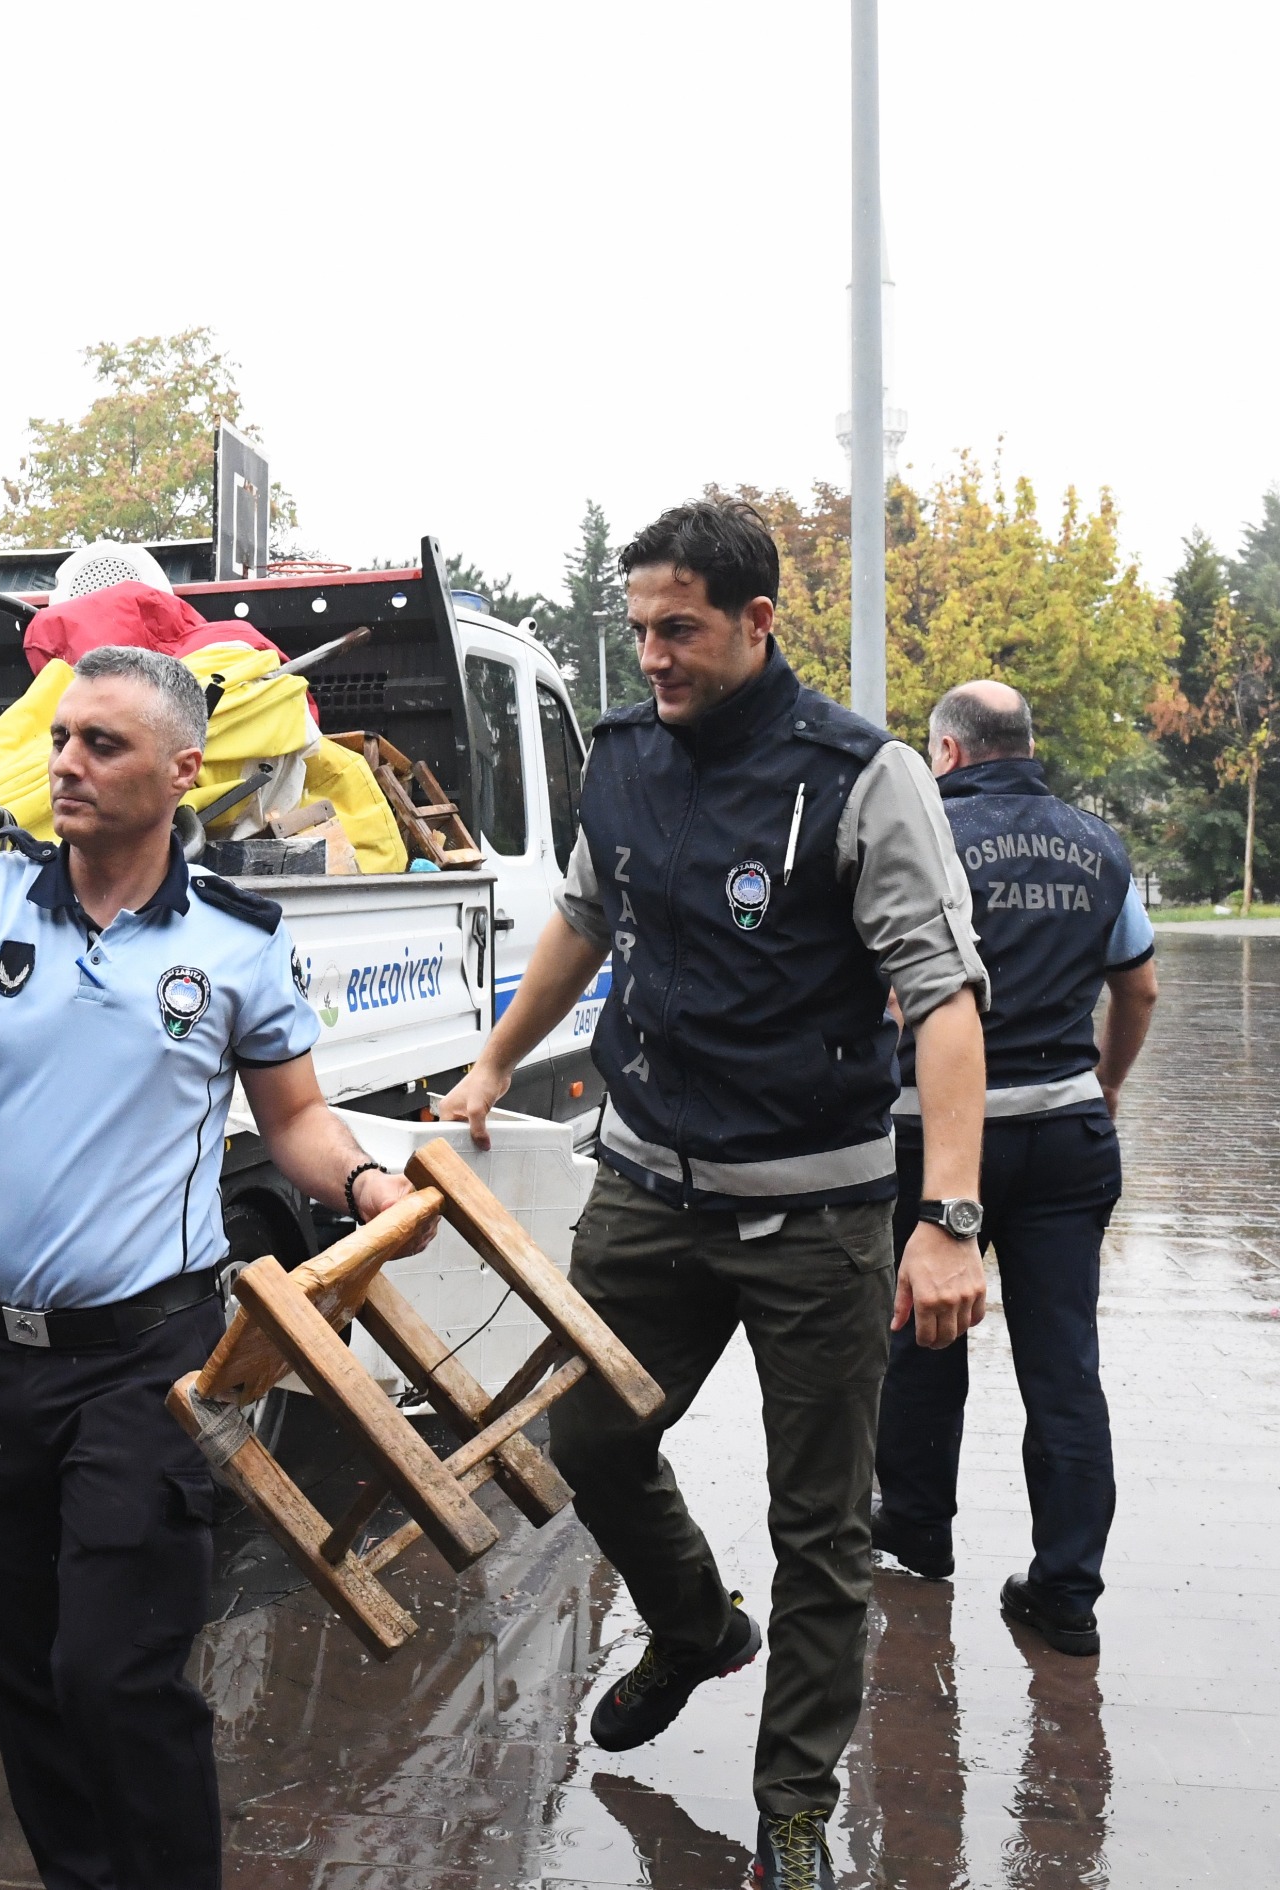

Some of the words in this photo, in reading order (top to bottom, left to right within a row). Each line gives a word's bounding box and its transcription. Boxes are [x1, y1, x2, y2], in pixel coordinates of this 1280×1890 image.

[739, 862, 764, 874] ZABITA
[965, 833, 1102, 880] OSMANGAZİ
[987, 881, 1091, 912] ZABITA
[175, 969, 202, 981] ZABITA
[346, 941, 443, 1013] BELEDİYESİ
